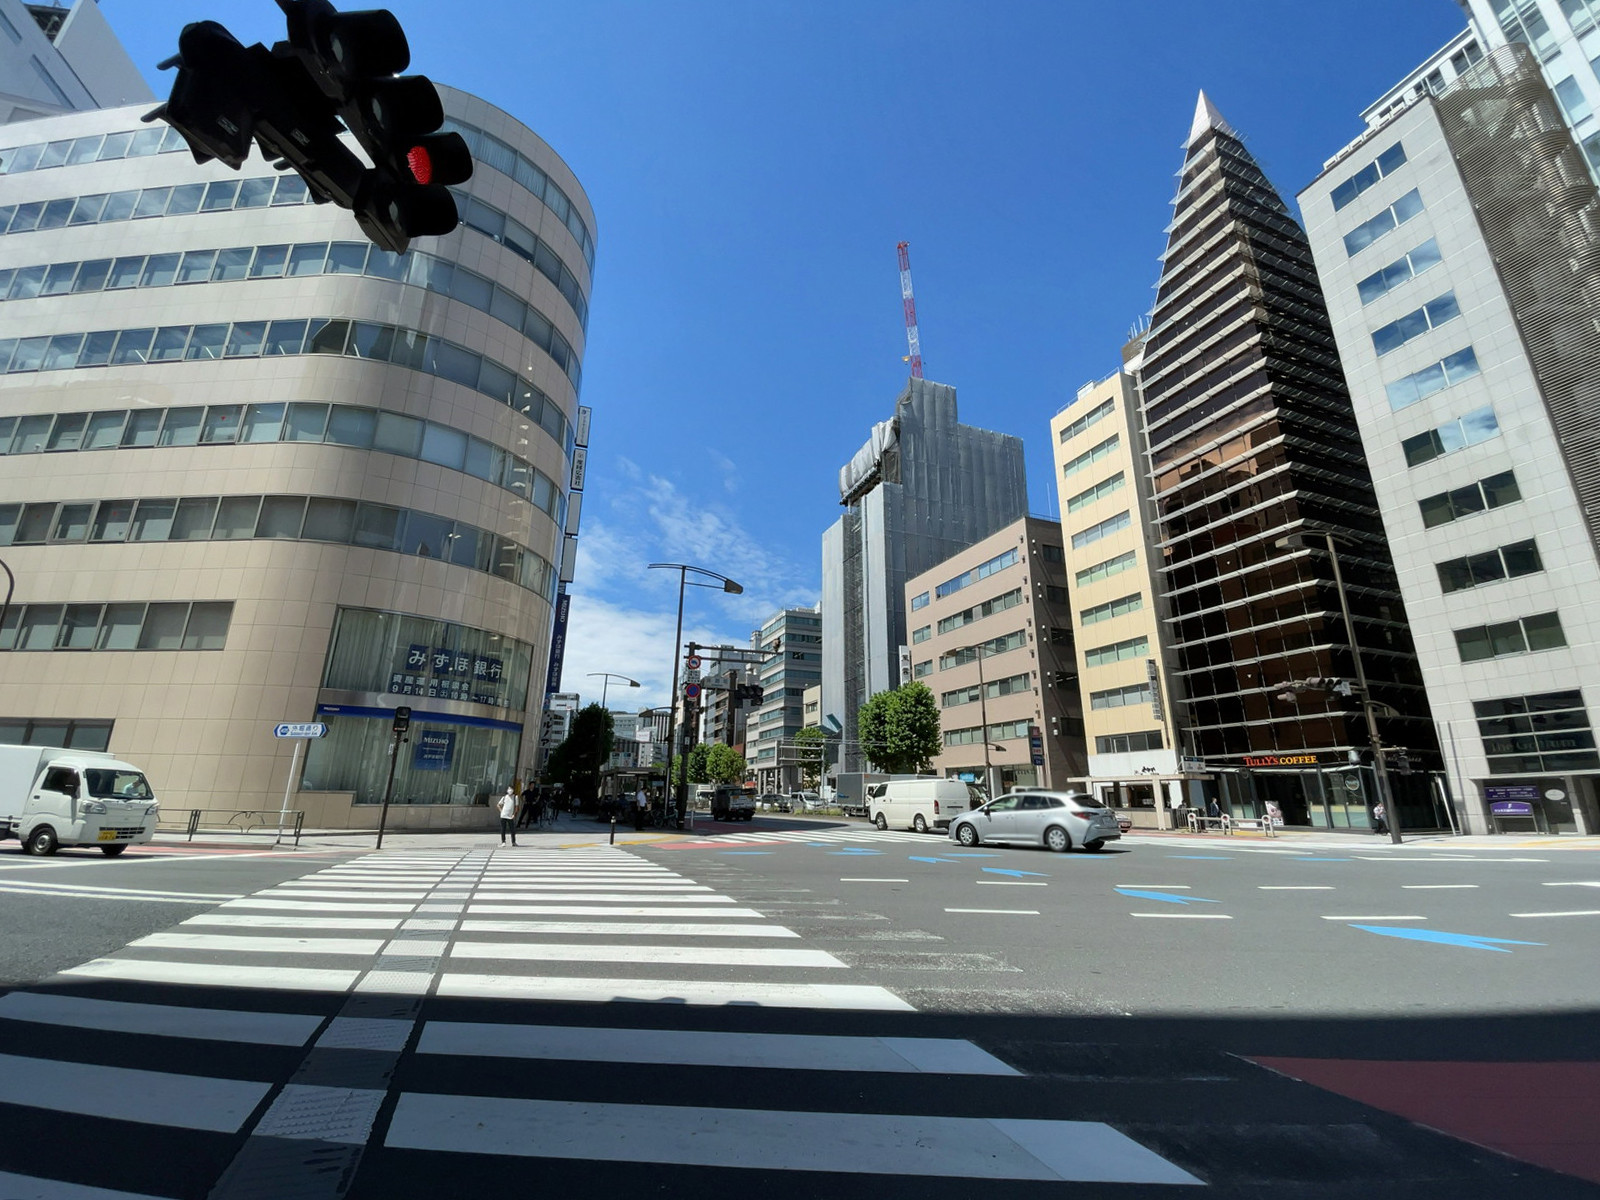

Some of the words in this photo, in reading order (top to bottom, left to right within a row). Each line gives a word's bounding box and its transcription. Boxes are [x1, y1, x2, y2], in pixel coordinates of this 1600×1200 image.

[408, 650, 502, 678] みずほ銀行
[1280, 755, 1318, 764] COFFEE
